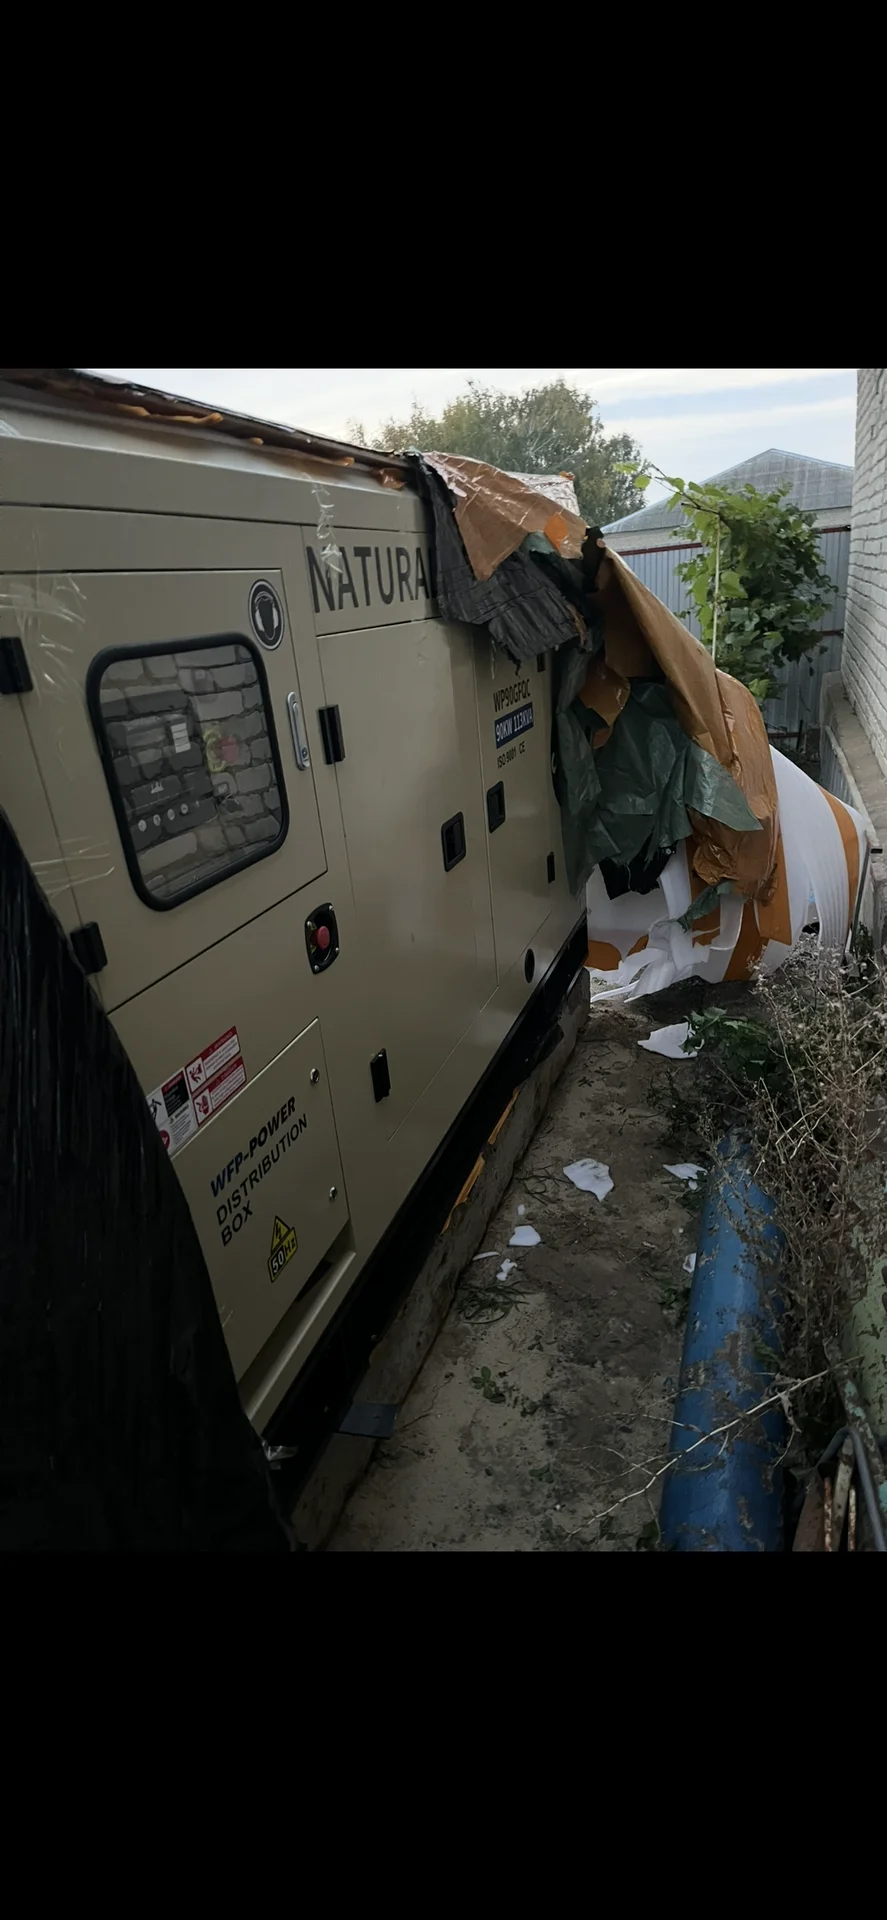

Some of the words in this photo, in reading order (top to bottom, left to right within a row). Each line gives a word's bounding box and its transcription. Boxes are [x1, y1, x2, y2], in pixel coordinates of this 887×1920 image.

[496, 717, 513, 742] 90KW
[497, 754, 506, 769] ISO
[519, 741, 526, 754] CE
[210, 1096, 296, 1198] WFP-POWER
[216, 1113, 308, 1226] DISTRIBUTION
[220, 1200, 253, 1247] BOX
